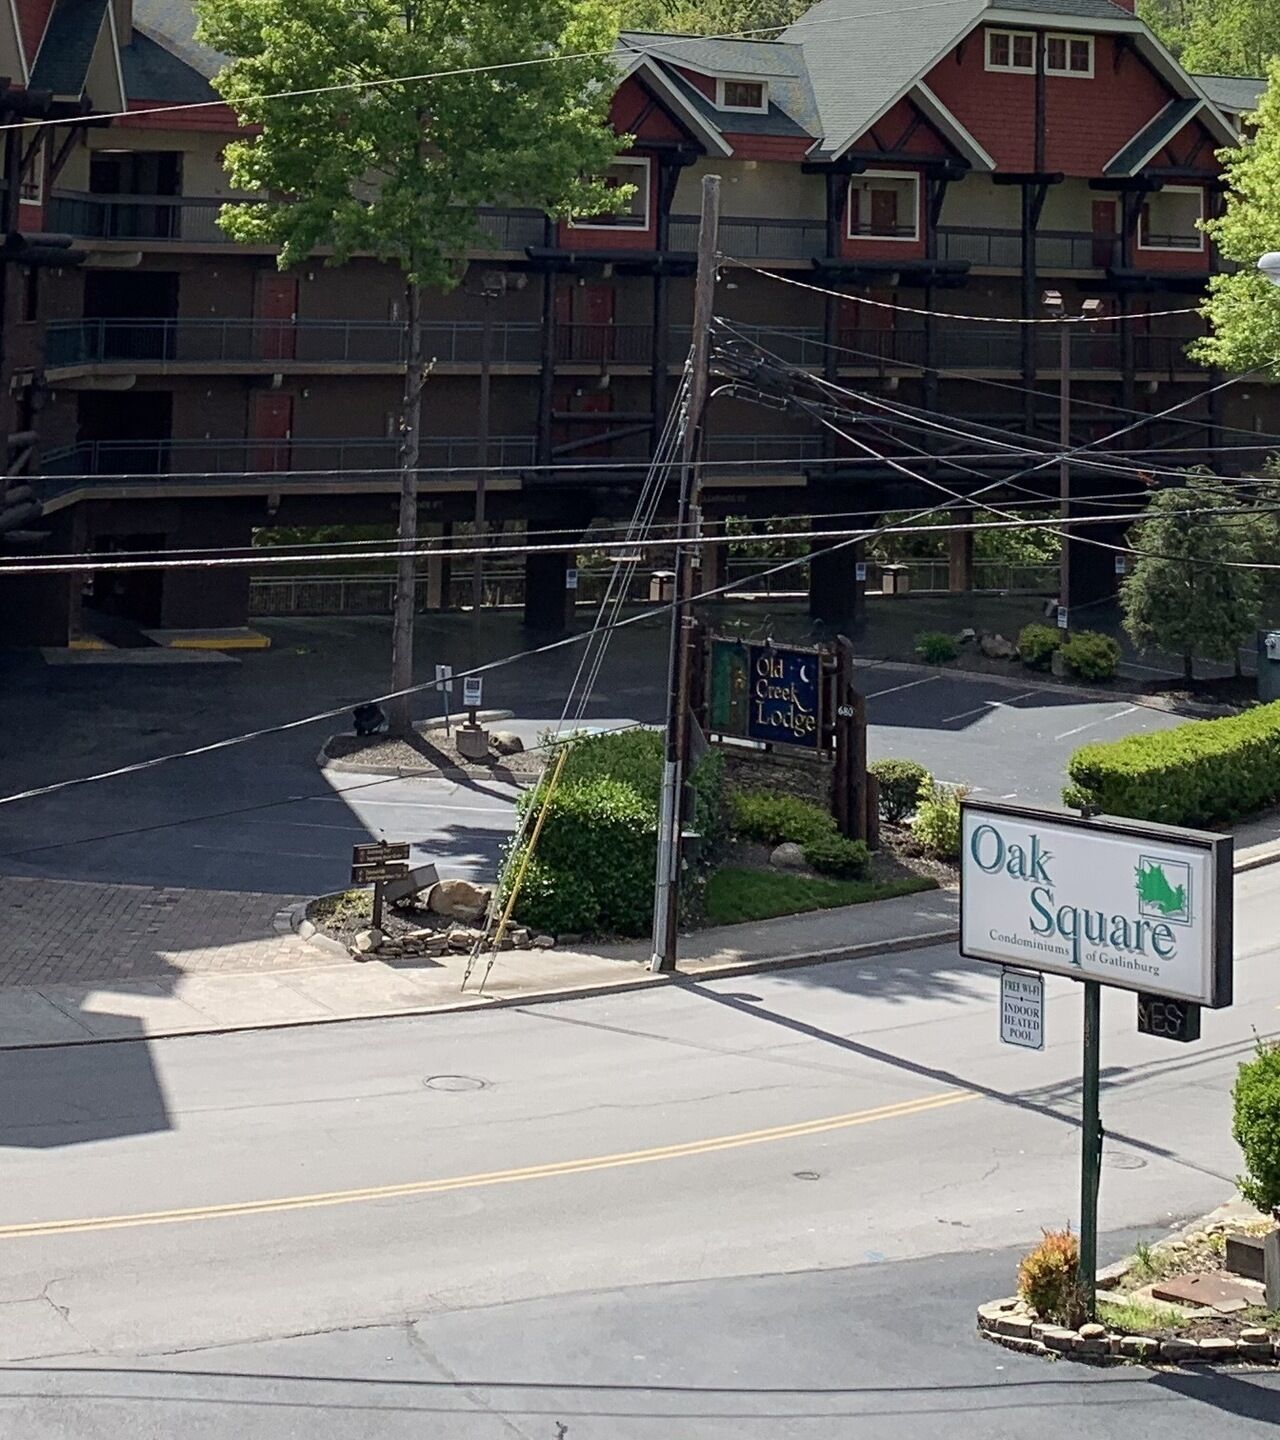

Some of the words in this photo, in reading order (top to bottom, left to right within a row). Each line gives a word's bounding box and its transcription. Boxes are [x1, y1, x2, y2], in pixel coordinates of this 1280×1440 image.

[756, 657, 784, 679] Old
[756, 678, 813, 713] Creek
[755, 700, 816, 738] Lodge
[970, 824, 1054, 885] Oak
[1029, 886, 1177, 967] Square
[989, 928, 1070, 956] Condominiums
[1085, 950, 1096, 961] of
[1099, 952, 1161, 977] Gatlinburg
[1004, 980, 1020, 993] FREE
[1004, 1002, 1040, 1019] INDOOR
[1004, 1014, 1040, 1031] HEATED
[1009, 1028, 1034, 1042] POOL
